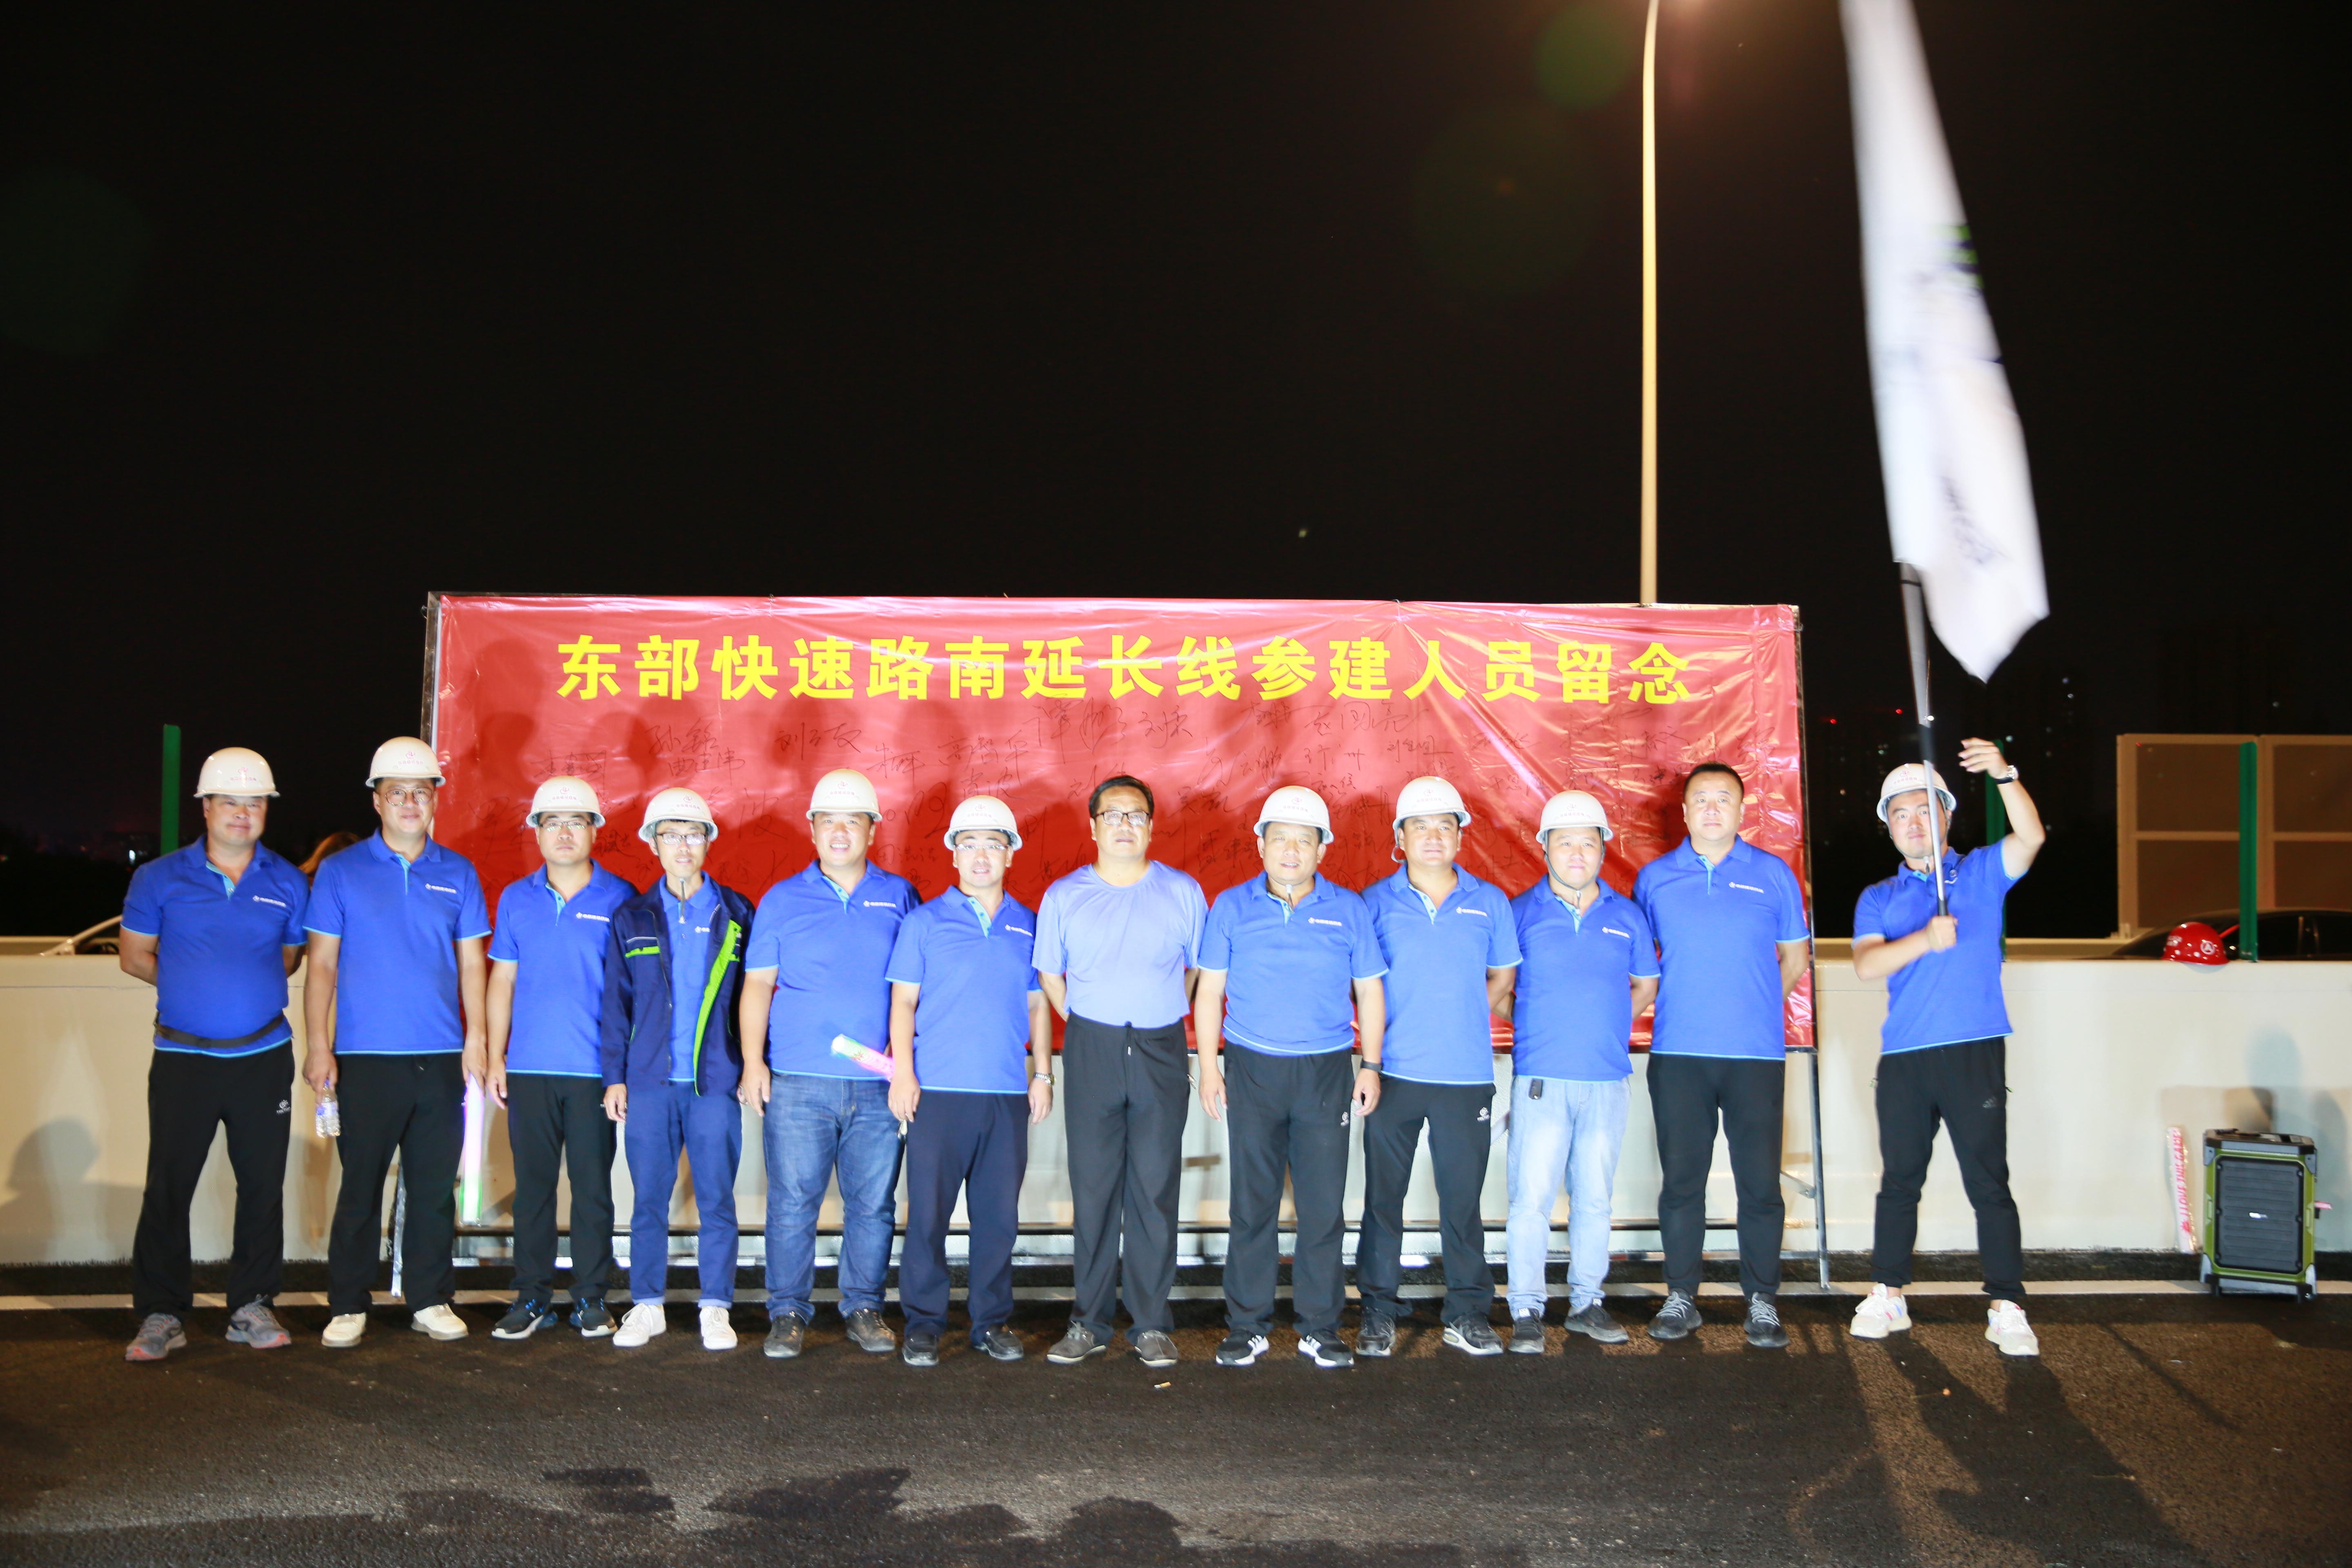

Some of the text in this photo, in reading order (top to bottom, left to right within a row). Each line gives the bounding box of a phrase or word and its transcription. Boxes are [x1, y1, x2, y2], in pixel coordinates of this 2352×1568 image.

[557, 634, 1690, 705] 东部快速路南延长线参建人员留念
